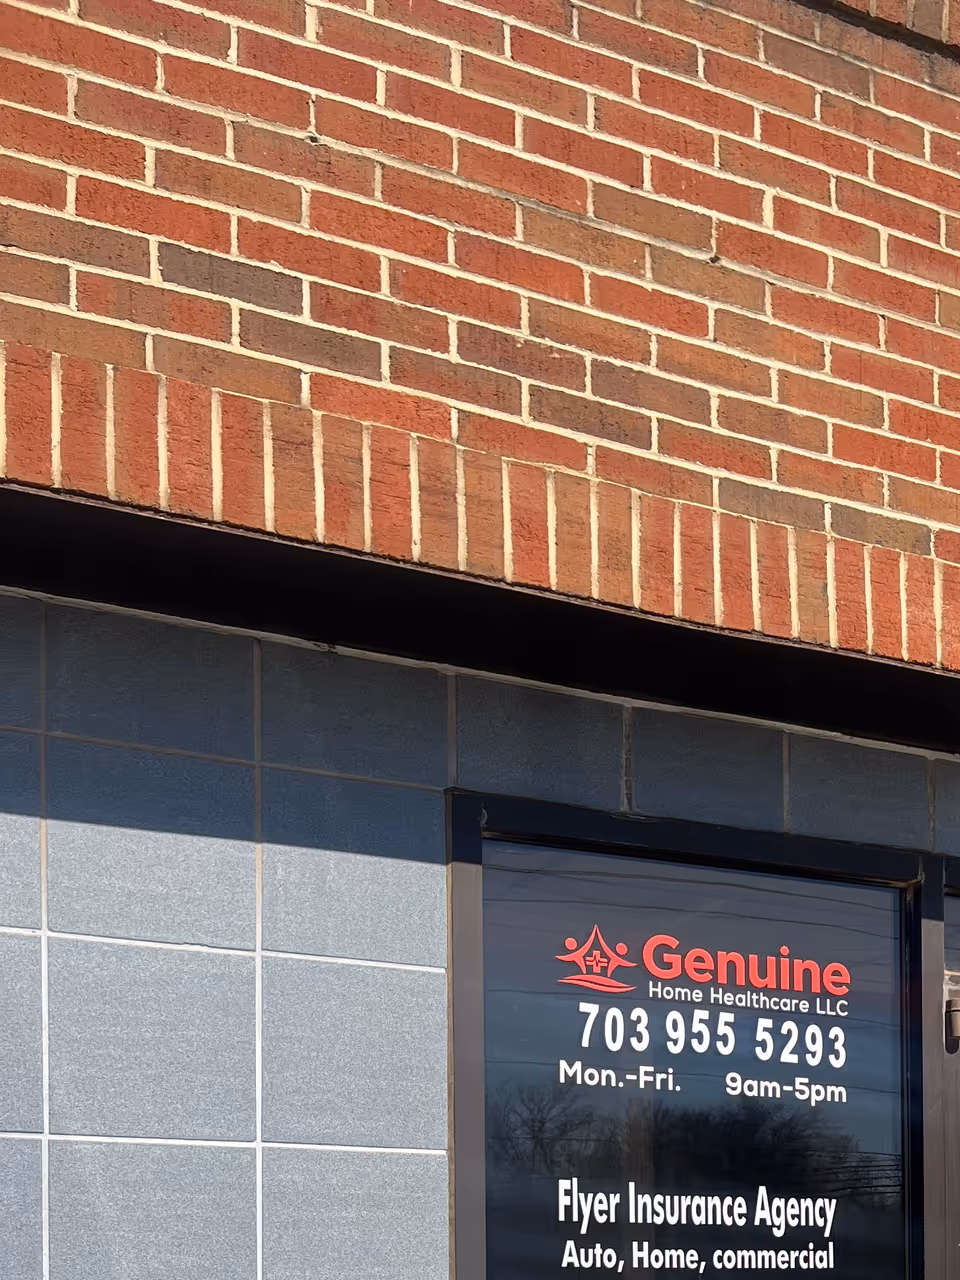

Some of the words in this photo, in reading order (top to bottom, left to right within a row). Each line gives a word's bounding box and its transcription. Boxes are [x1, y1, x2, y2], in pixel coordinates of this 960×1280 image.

[642, 934, 851, 996] Genuine
[649, 981, 703, 1002] Home
[710, 987, 810, 1014] Healthcare
[816, 998, 849, 1016] LLC
[579, 1002, 650, 1052] 703
[665, 1008, 735, 1055] 955
[755, 1017, 846, 1069] 5293
[559, 1060, 681, 1091] Mon.-Fri.
[725, 1072, 847, 1106] 9am-5pm
[558, 1177, 620, 1234] Flyer
[629, 1181, 747, 1226] Insurance
[754, 1185, 837, 1237] Agency
[561, 1240, 625, 1273] Auto,
[632, 1241, 706, 1273] Home,
[713, 1242, 834, 1270] commercial
